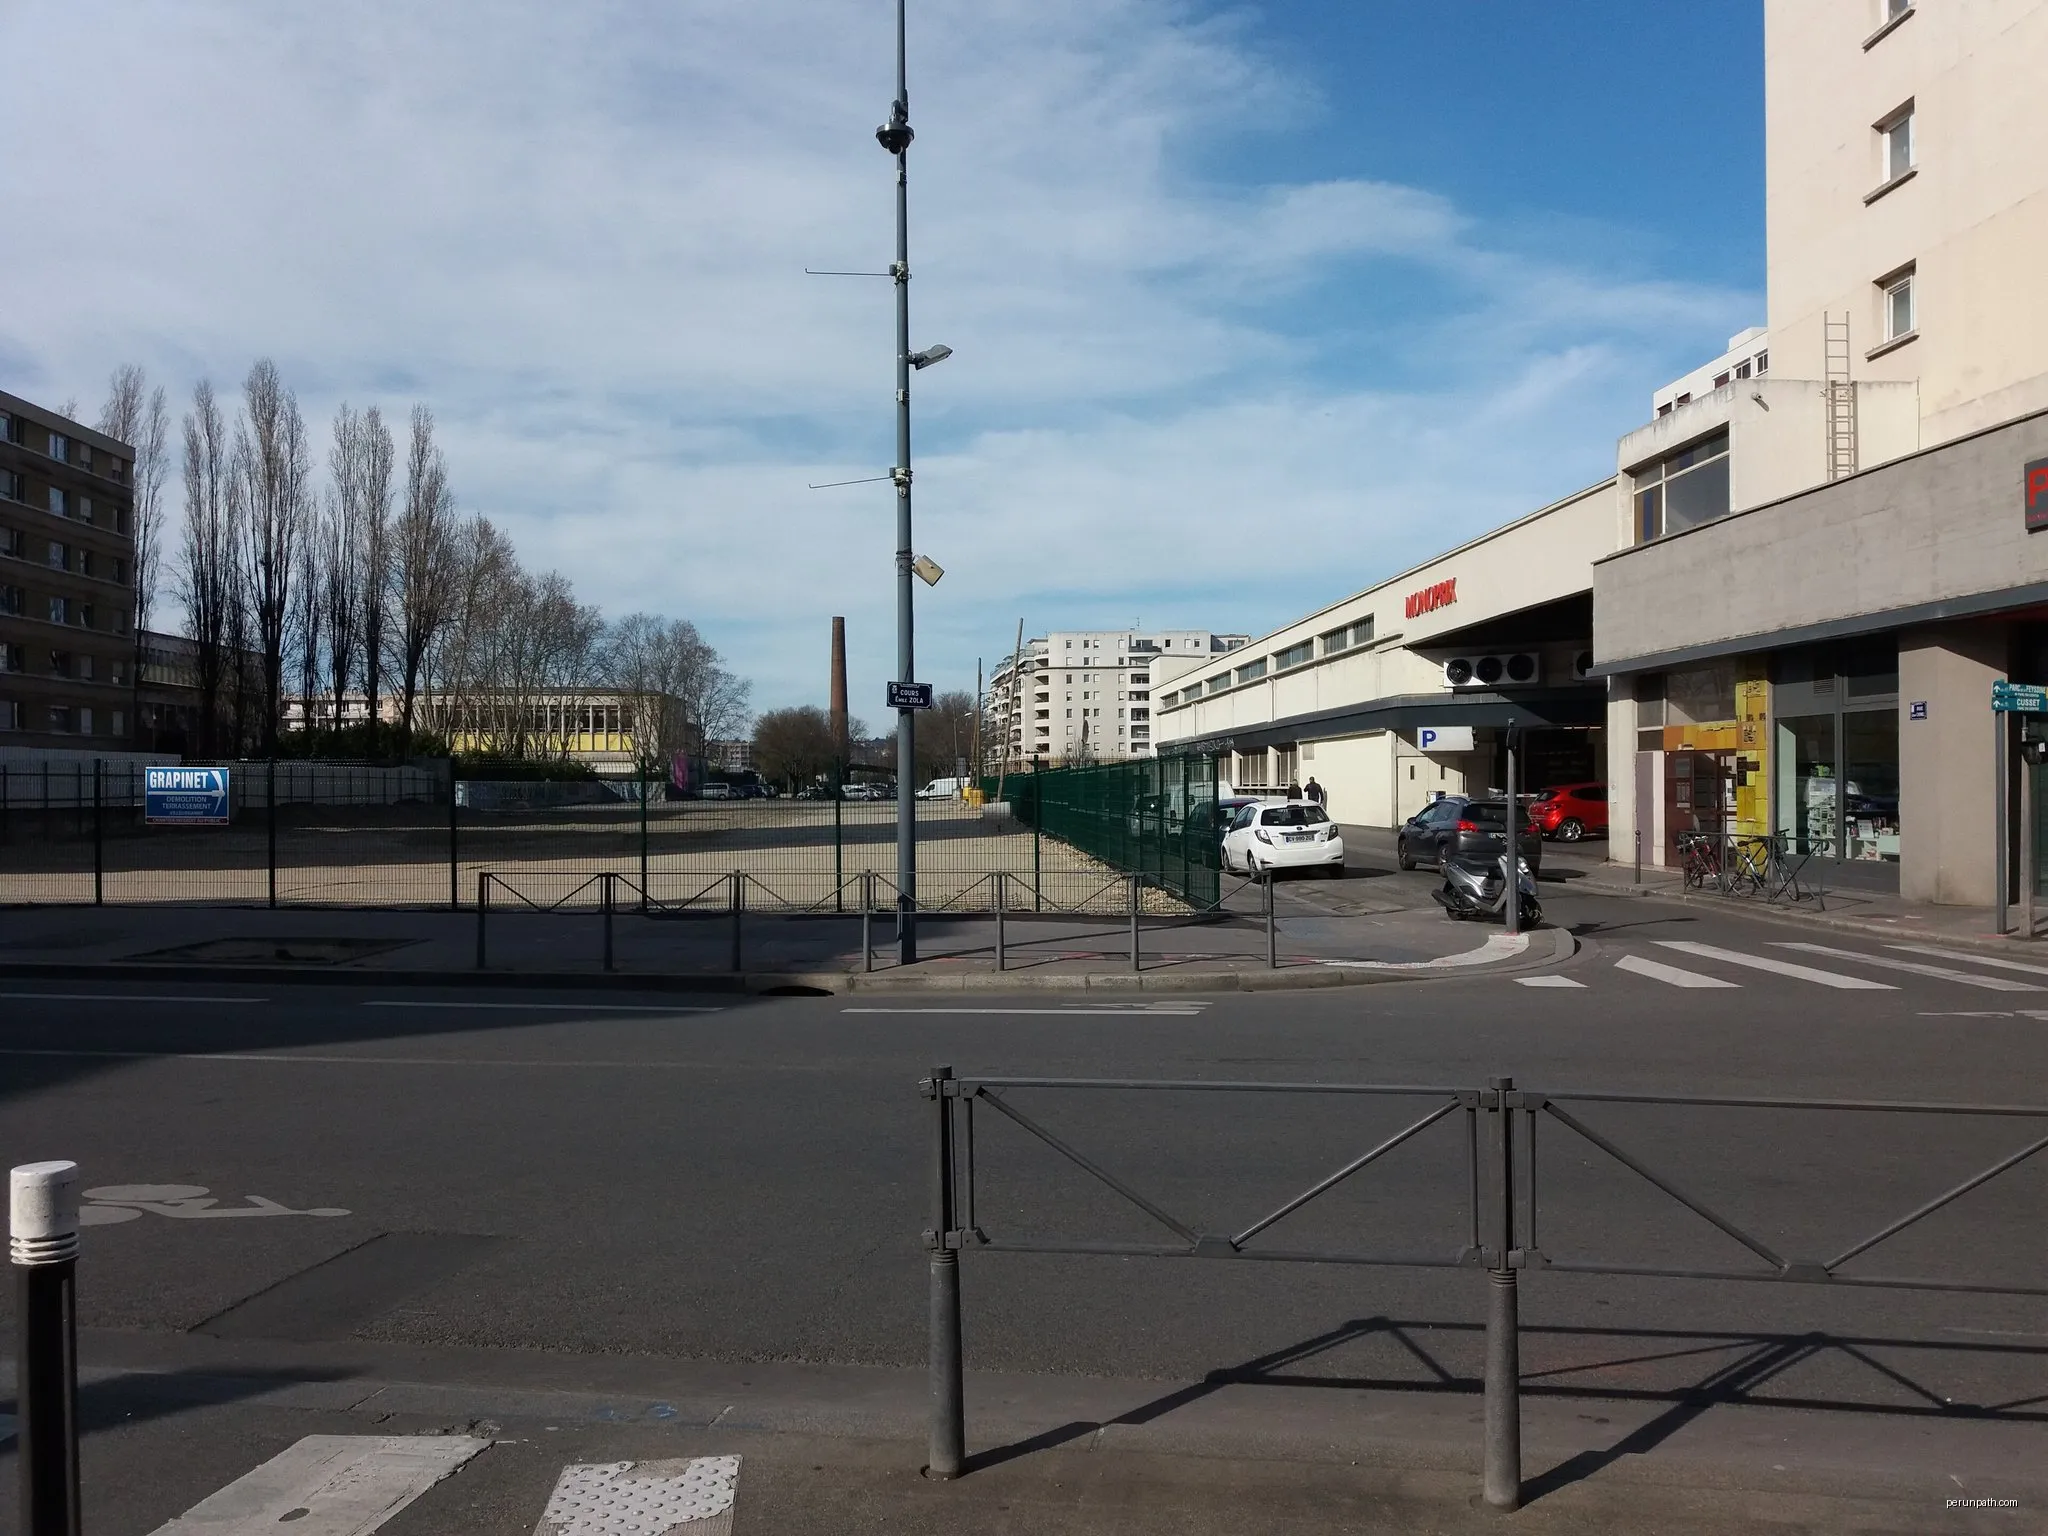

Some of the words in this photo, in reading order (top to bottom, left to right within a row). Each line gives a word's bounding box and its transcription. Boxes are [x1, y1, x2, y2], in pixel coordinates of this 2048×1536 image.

[1405, 576, 1457, 619] MONOPRIX
[900, 689, 919, 697] COURS
[2016, 698, 2040, 706] CUSSET
[1422, 730, 1437, 748] P
[149, 771, 209, 789] GRAPINET
